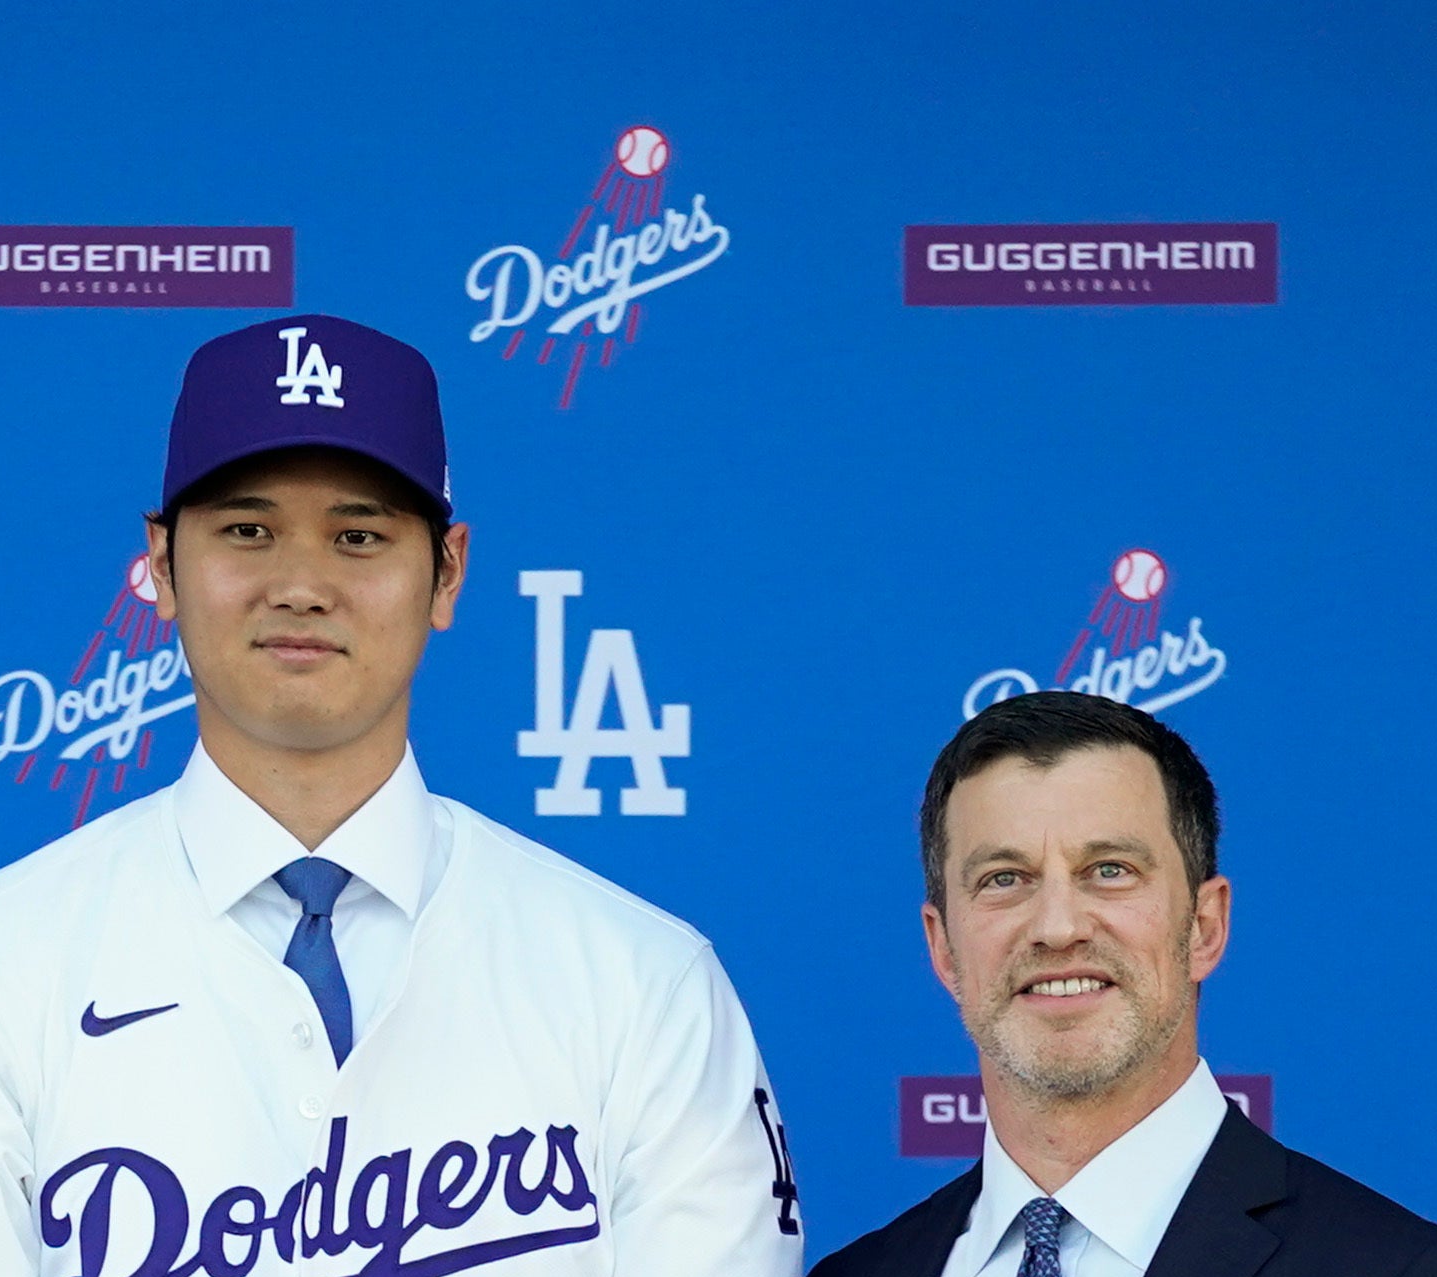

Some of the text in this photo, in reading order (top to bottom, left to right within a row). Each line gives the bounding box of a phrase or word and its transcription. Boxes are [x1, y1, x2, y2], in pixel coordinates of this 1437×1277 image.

[40, 281, 167, 294] BASEBALL
[465, 193, 730, 343] Dodgers
[927, 241, 1255, 272] GUGGENHEIM
[275, 327, 345, 408] LA
[516, 569, 691, 817] LA
